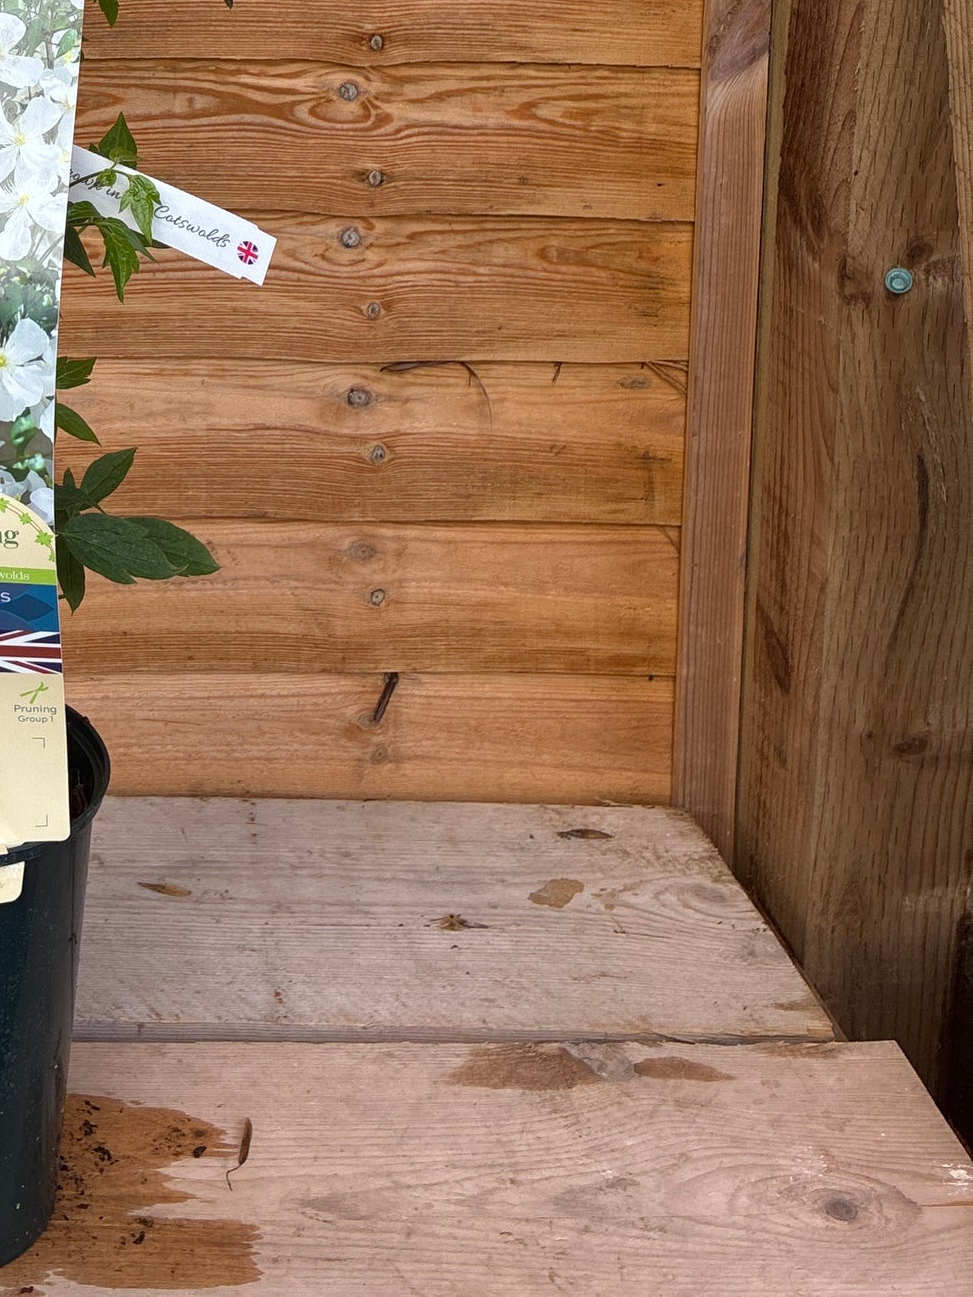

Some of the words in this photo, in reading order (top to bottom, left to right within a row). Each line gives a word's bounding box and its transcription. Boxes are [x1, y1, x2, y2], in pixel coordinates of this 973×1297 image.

[106, 186, 121, 200] in
[154, 205, 231, 248] Cotswolds
[13, 704, 57, 715] Pruning
[17, 715, 47, 724] Group
